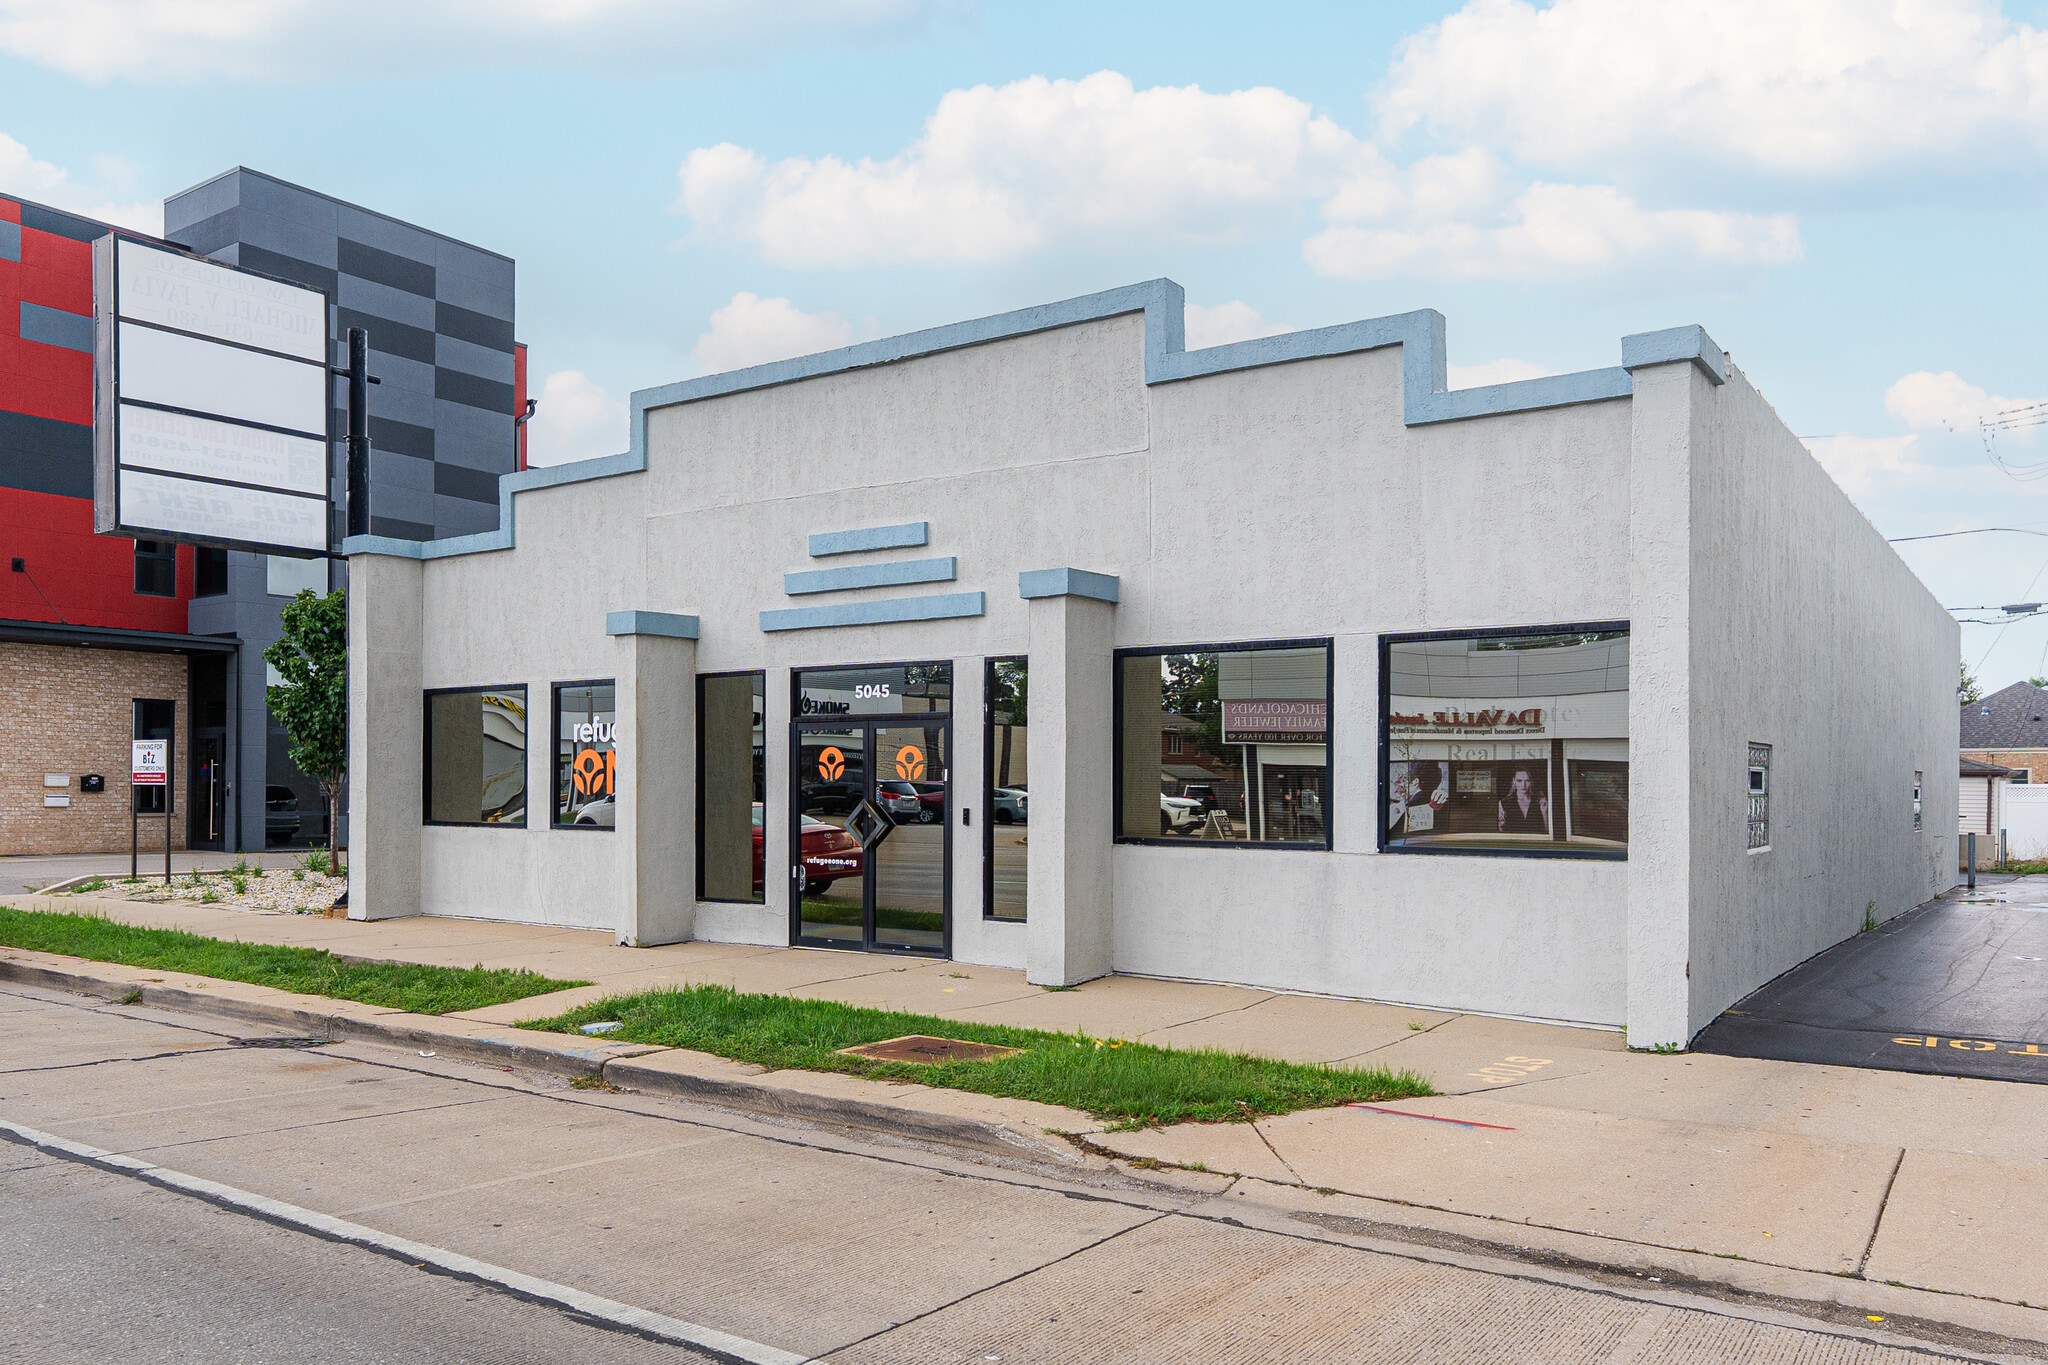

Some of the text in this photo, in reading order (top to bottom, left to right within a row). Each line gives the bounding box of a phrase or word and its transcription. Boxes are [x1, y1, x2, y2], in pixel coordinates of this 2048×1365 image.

[854, 683, 891, 699] 5045
[806, 856, 857, 867] refugeeone.org
[1466, 1055, 1554, 1084] STOP
